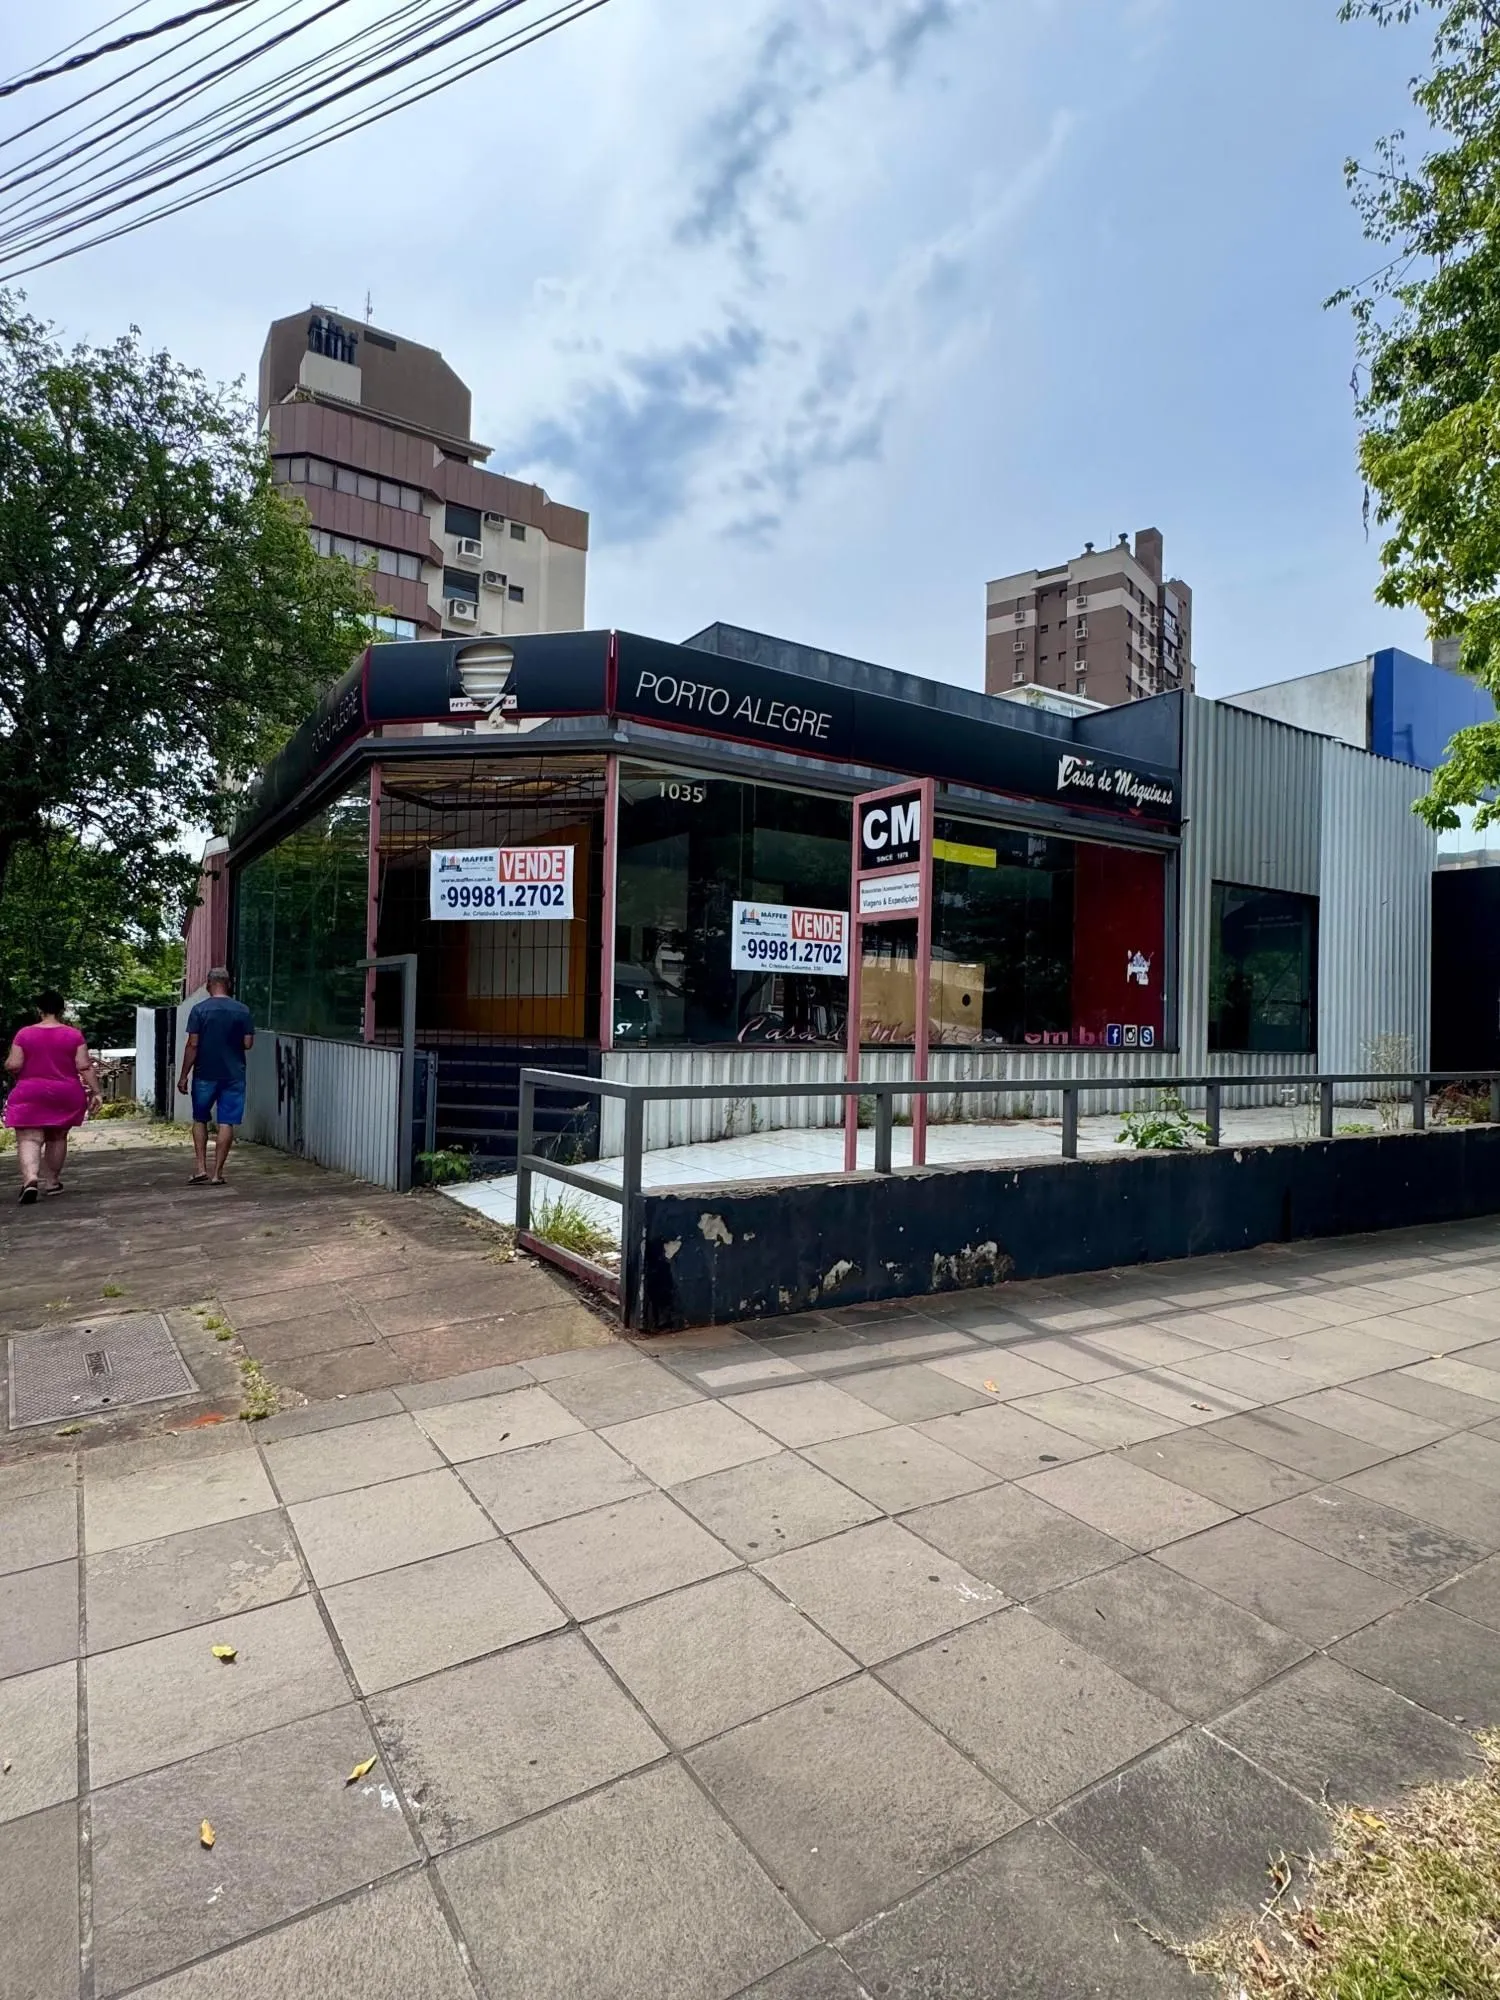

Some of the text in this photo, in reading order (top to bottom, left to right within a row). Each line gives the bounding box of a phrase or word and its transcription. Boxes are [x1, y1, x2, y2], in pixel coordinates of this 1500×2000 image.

[635, 671, 833, 739] PORTO ALEGRE
[1058, 757, 1095, 790] Casa
[1098, 769, 1112, 791] de
[658, 781, 704, 803] 1035
[863, 800, 920, 850] CM
[502, 852, 563, 880] VENDE
[876, 854, 893, 862] SINCE
[447, 884, 564, 907] 99981.2702
[863, 899, 882, 907] Viagens
[888, 895, 918, 905] Expedições
[794, 911, 841, 941] VENDE
[748, 938, 841, 964] 99981.2702
[737, 1013, 816, 1043] Casa
